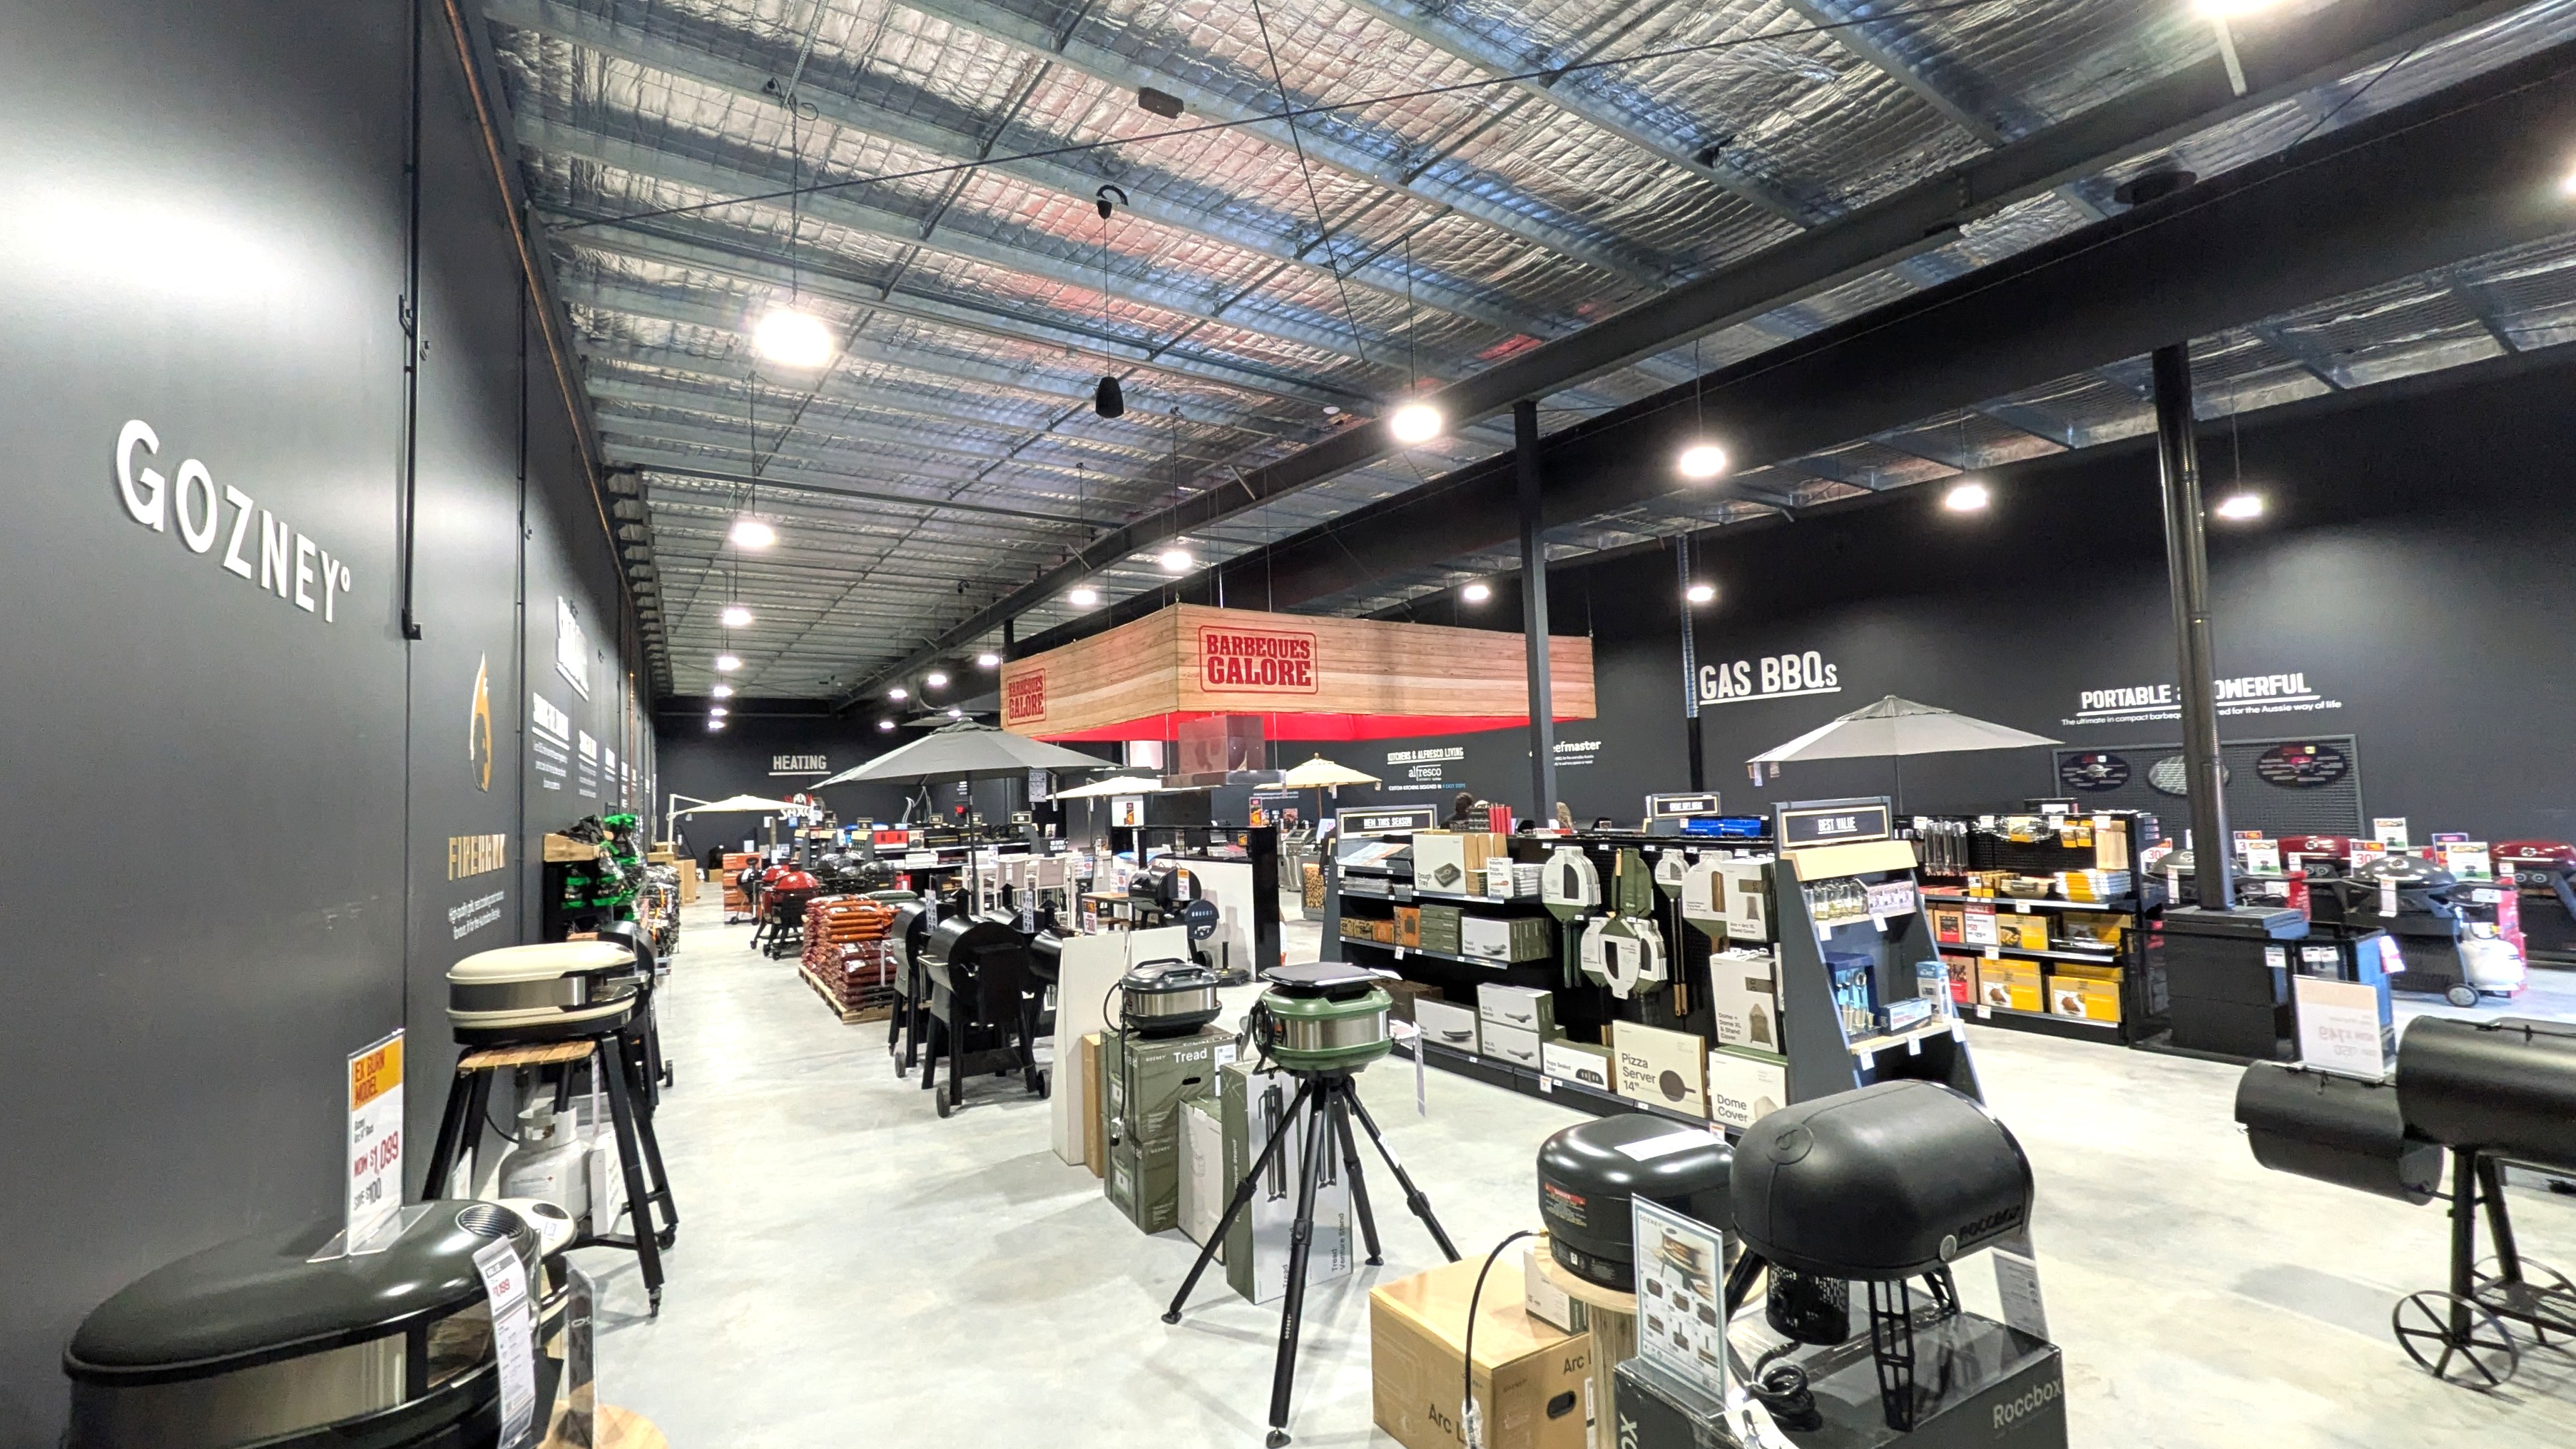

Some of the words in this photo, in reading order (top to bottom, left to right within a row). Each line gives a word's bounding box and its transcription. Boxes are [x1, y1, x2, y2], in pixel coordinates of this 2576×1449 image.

[1206, 634, 1310, 659] BARBEQUES
[1208, 656, 1311, 686] GALORE
[1700, 661, 1751, 699] GAS
[1761, 651, 1838, 693] BBQs
[1009, 675, 1043, 697] BARBEQUES
[2081, 684, 2172, 709] PORTABLE
[2215, 673, 2311, 699] OWERFUL
[1009, 693, 1044, 719] GALORE
[2115, 714, 2148, 723] compact
[2261, 704, 2291, 713] Aussie
[2314, 701, 2325, 709] of
[2326, 700, 2342, 708] life
[1412, 750, 1417, 759] &
[1417, 748, 1443, 759] ALFRESCO
[1445, 747, 1464, 757] LIVING
[1553, 741, 1602, 753] efmaster
[773, 755, 827, 770] HEATING
[1408, 764, 1442, 781] alfresco
[1364, 818, 1375, 827] NEW
[1378, 818, 1390, 826] THIS
[1392, 817, 1412, 825] SEASON
[1818, 818, 1834, 831] BEST
[1836, 817, 1855, 830] VALUE
[1417, 873, 1432, 883] Dough
[1419, 879, 1429, 888] Tray
[1173, 1048, 1208, 1063] Tread
[1622, 1052, 1649, 1069] Pizza
[1623, 1067, 1656, 1084] Server
[1717, 1094, 1747, 1110] Dome
[1718, 1107, 1748, 1122] Cover
[1563, 1356, 1584, 1375] Arc
[1992, 1378, 2062, 1429] Roccbox
[1428, 1403, 1452, 1434] Arc
